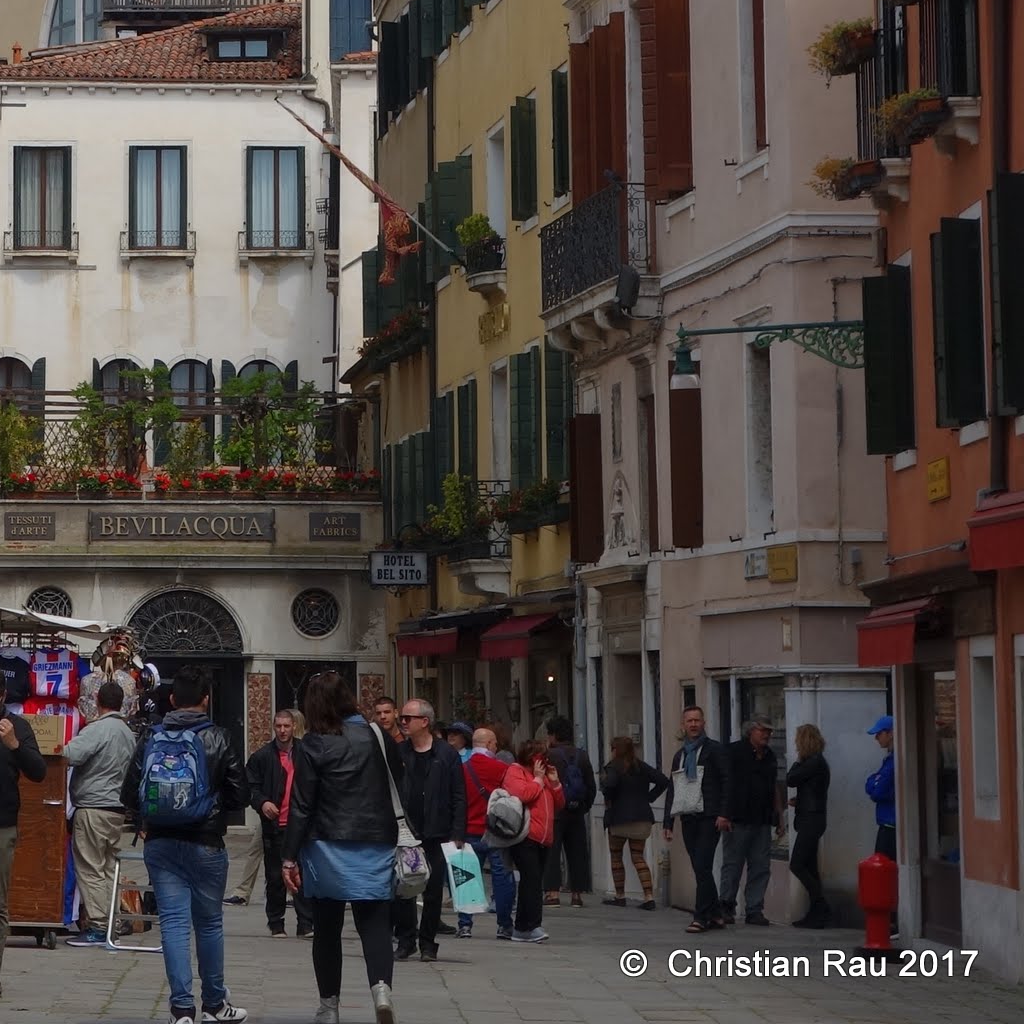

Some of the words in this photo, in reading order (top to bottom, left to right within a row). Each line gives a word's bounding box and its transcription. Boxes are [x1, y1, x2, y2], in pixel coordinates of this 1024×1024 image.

[9, 516, 52, 524] TESSUTI
[323, 517, 346, 525] ART
[100, 516, 263, 539] BEVILACQUA
[313, 528, 357, 536] FABRICS
[384, 555, 415, 566] HOTEL
[377, 569, 395, 580] BEL
[399, 569, 422, 580] SITO
[33, 661, 73, 672] GRIEZMANN
[46, 673, 63, 695] 7
